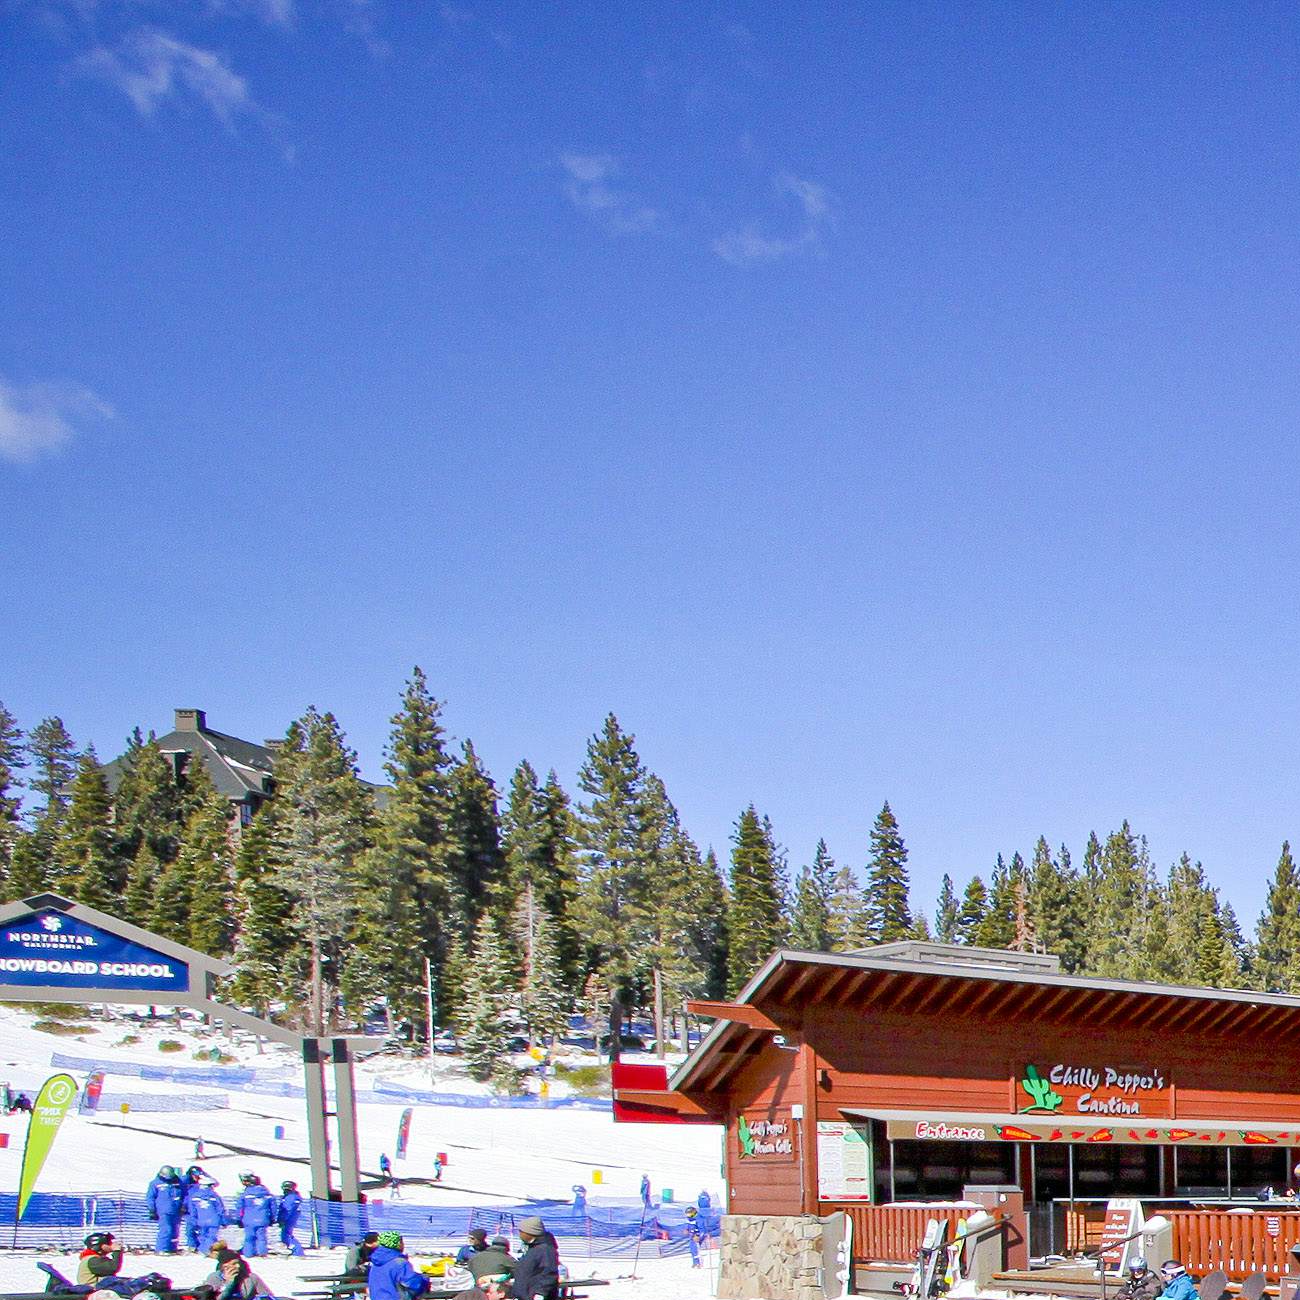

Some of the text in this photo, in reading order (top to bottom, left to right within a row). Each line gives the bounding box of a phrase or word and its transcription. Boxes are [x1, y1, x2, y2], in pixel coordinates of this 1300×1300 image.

[9, 933, 95, 946] NORTHSTAR
[24, 942, 83, 950] CALIFORNIA
[101, 962, 174, 978] SCHOOL
[1050, 1064, 1163, 1093] Chilly Pepper's
[1077, 1093, 1140, 1114] Cantina
[916, 1121, 985, 1140] Entrance
